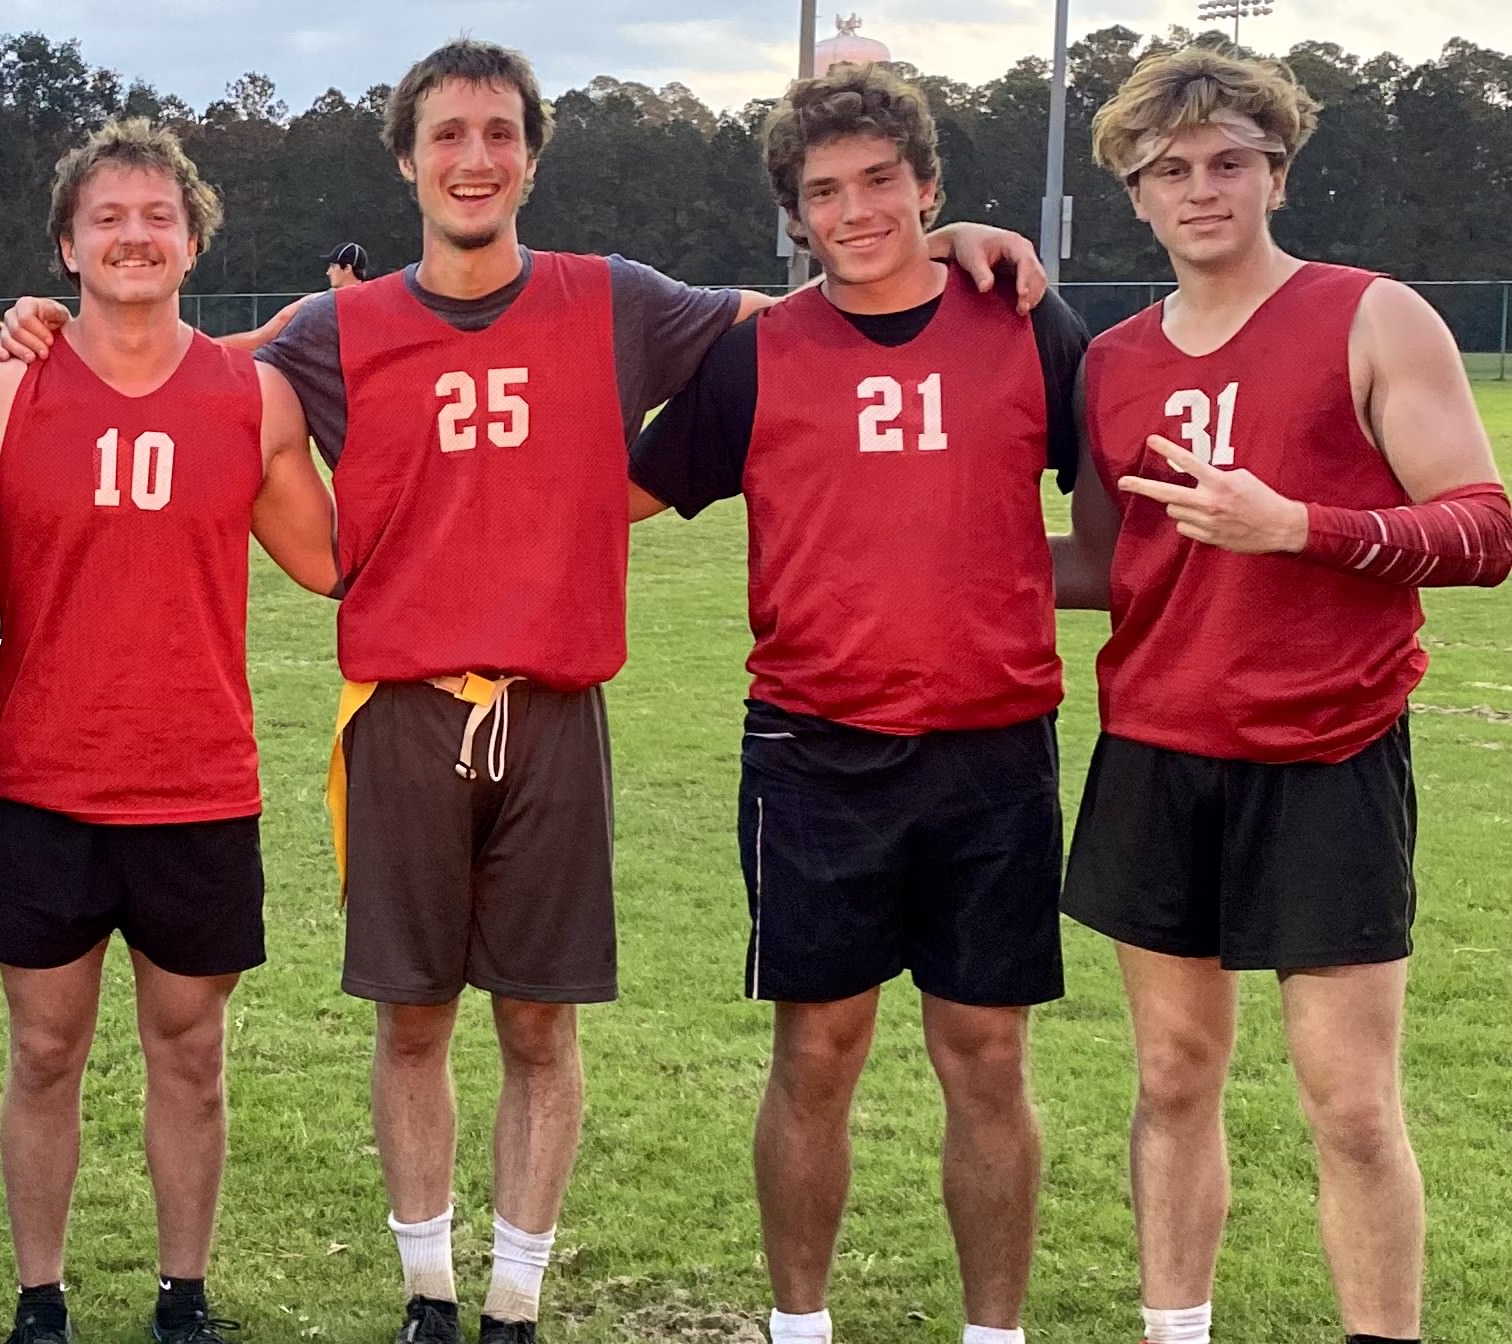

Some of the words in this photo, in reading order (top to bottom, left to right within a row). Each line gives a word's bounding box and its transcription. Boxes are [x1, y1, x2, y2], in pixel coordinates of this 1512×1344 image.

[434, 366, 530, 454] 25
[855, 371, 949, 453] 21
[1163, 380, 1240, 470] 31
[93, 427, 176, 512] 10
